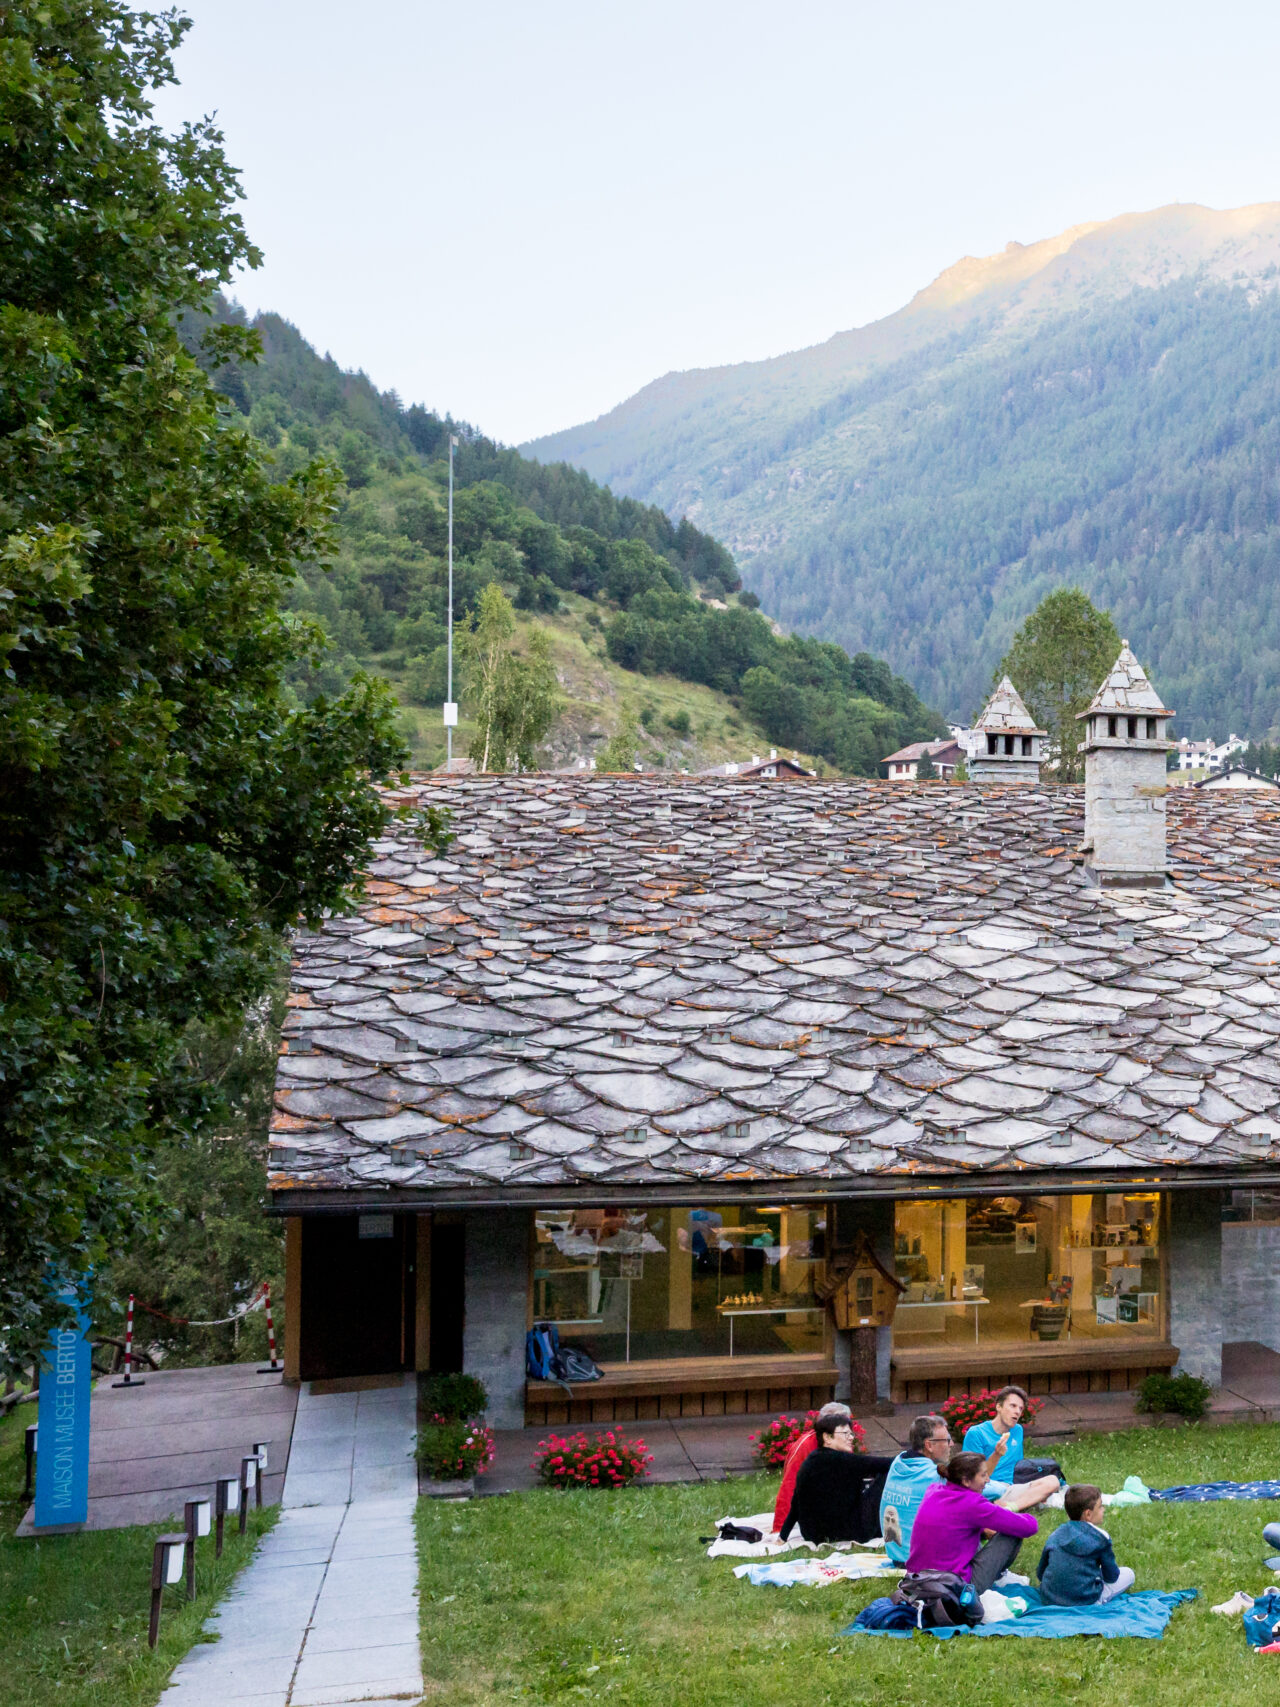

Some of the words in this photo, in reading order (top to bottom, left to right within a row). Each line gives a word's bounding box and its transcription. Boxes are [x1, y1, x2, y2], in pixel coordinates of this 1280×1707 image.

[57, 1328, 77, 1384] BERTO
[54, 1388, 75, 1442] MUSÉE
[53, 1446, 74, 1509] MAISON
